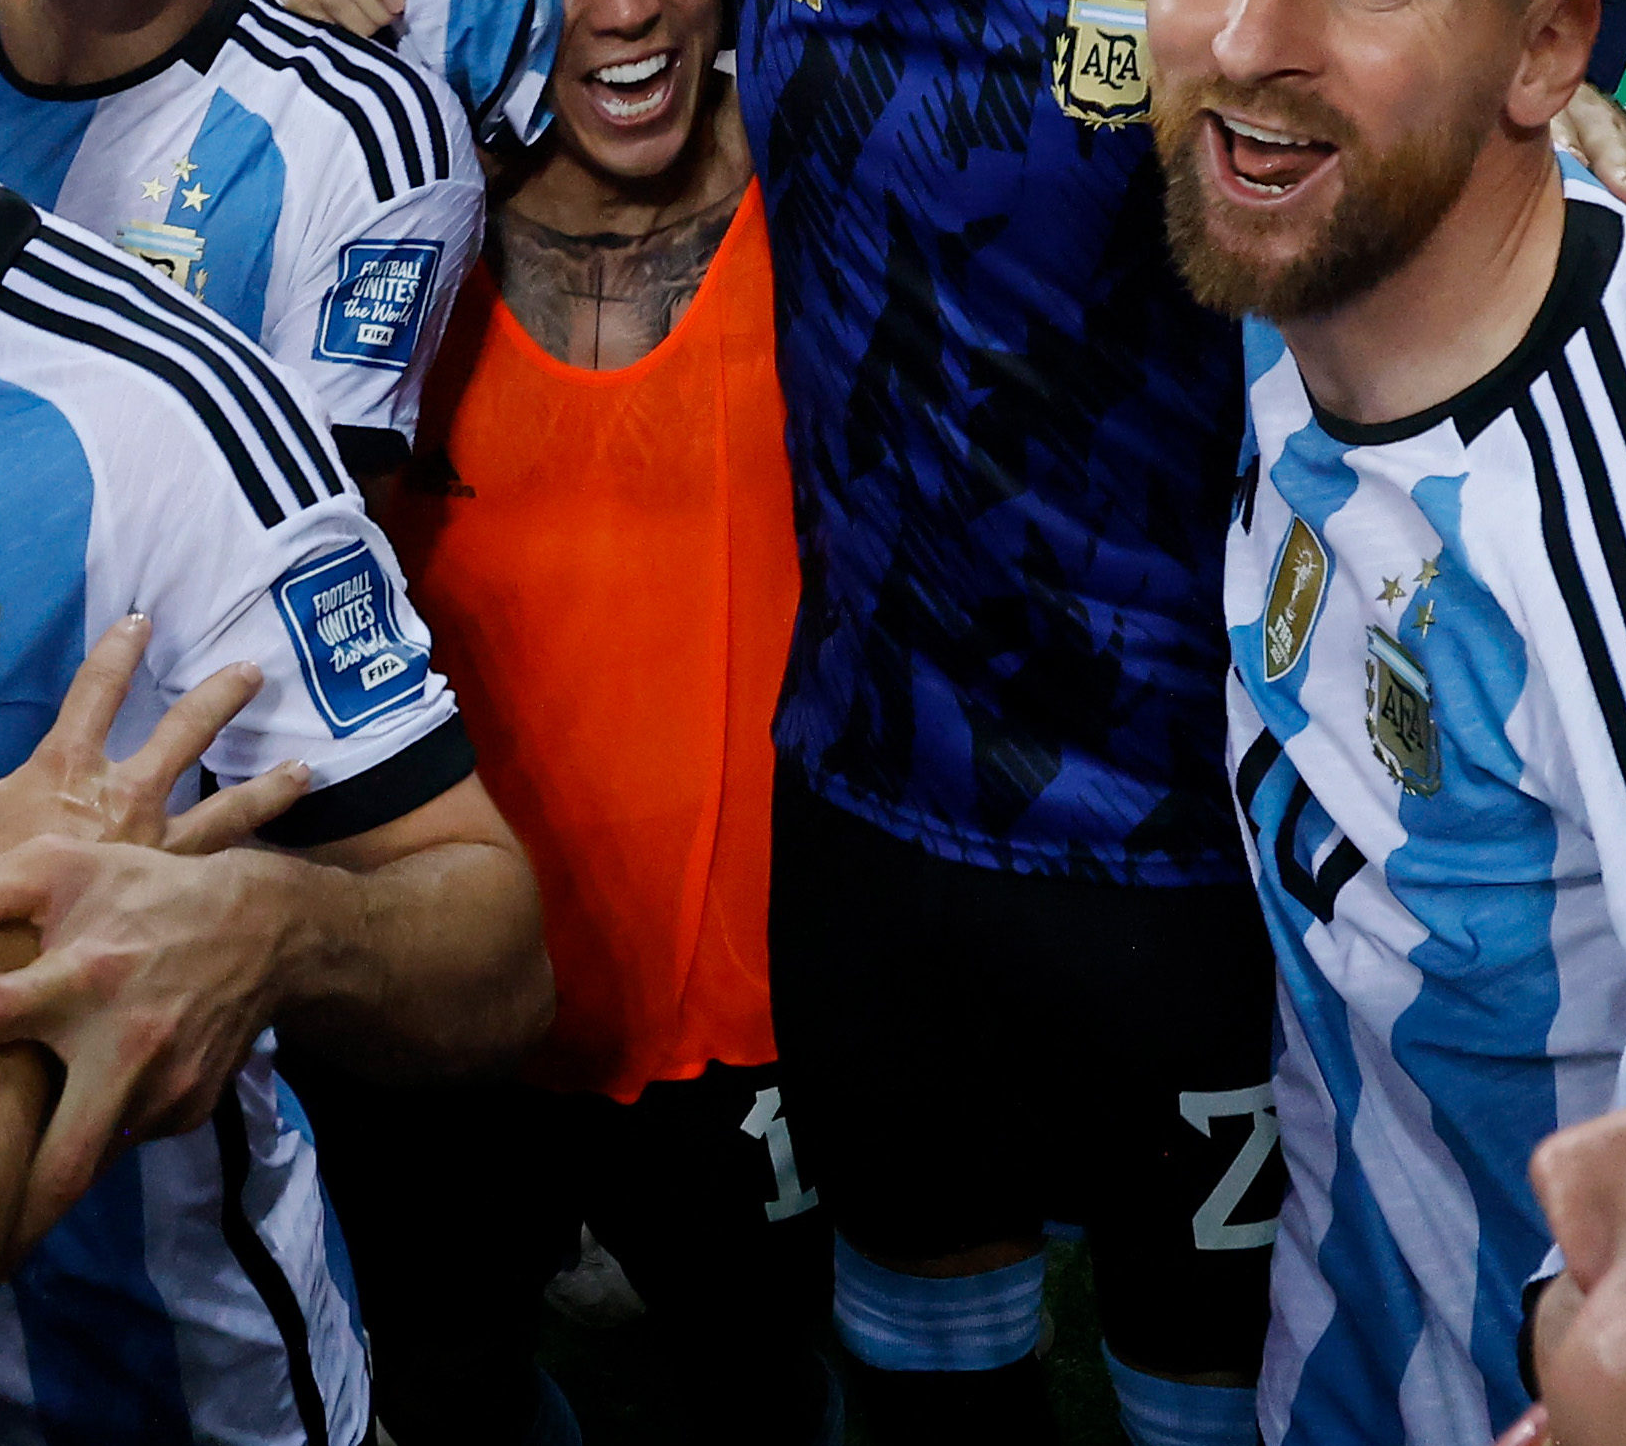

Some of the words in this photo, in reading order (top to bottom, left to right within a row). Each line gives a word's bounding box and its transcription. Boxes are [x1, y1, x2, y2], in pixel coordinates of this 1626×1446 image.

[1080, 28, 1141, 90] AFA
[360, 259, 422, 279] FOOTBALL
[352, 276, 419, 304] UNITES
[343, 297, 371, 320] the
[371, 300, 414, 327] World
[363, 328, 389, 342] FIFA
[312, 569, 373, 618] FOOTBALL
[316, 593, 376, 647] UNITES
[368, 657, 401, 682] FIFA
[1381, 667, 1425, 753] AFA
